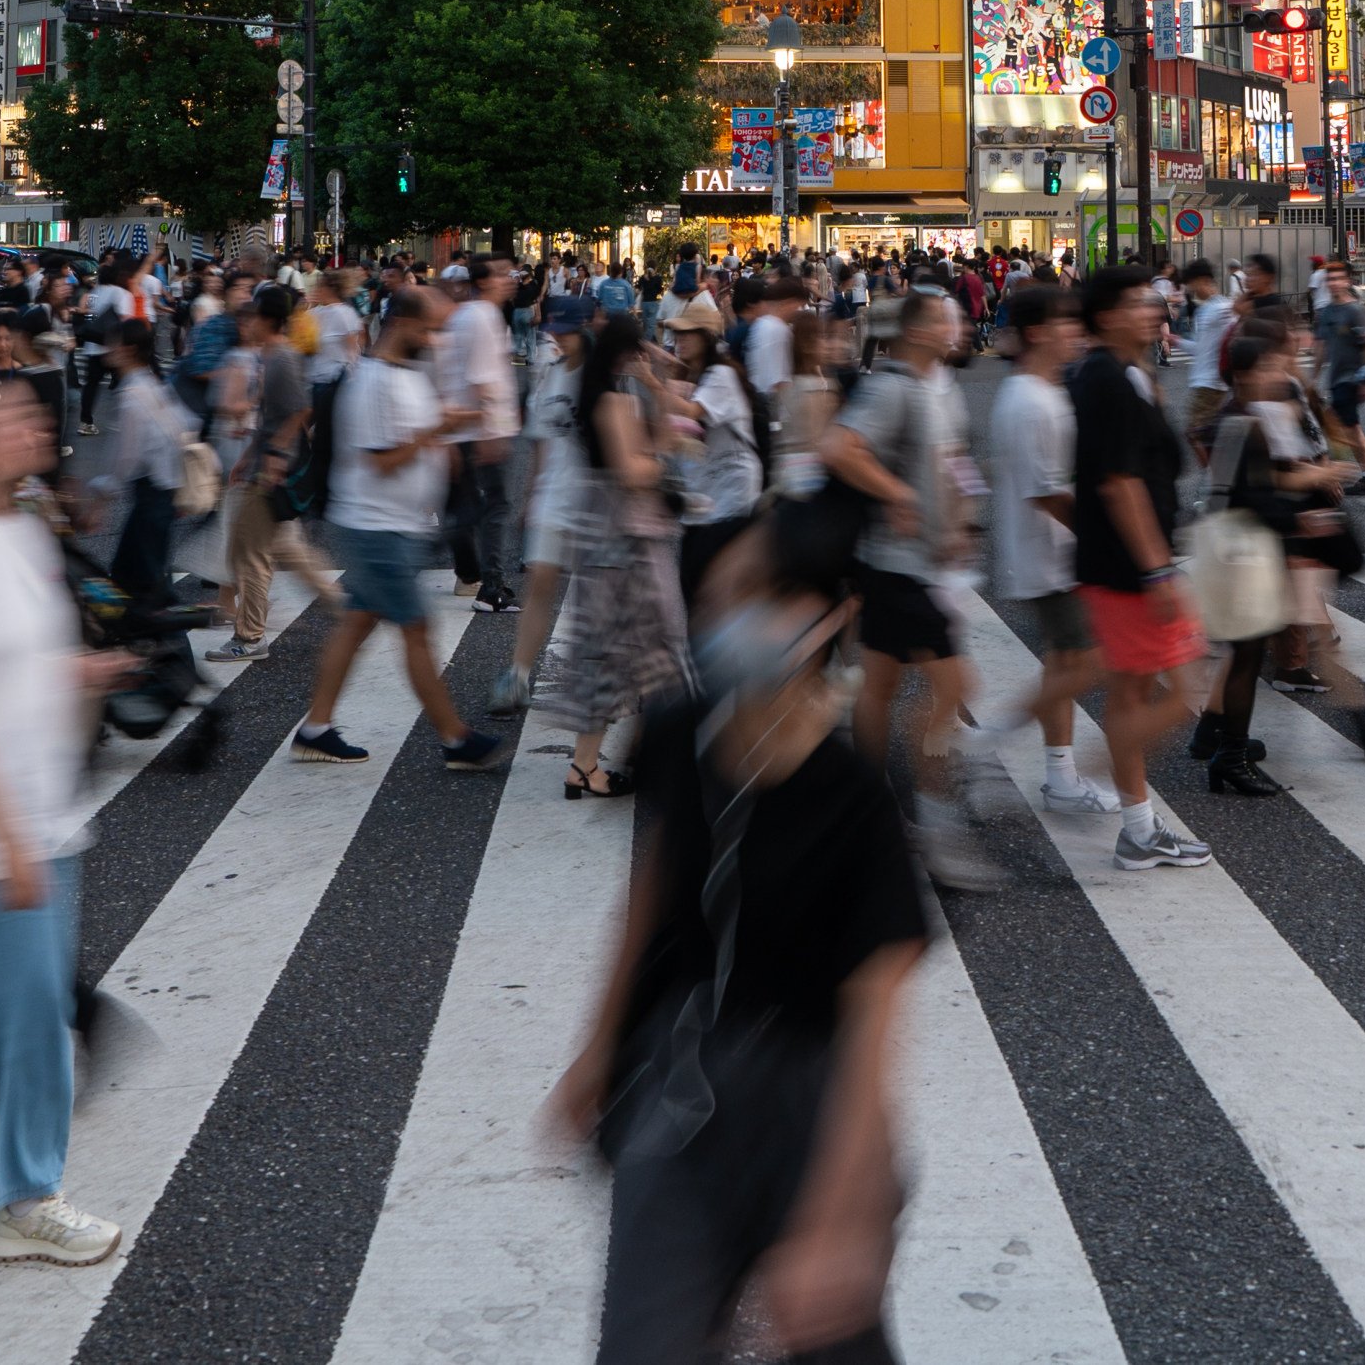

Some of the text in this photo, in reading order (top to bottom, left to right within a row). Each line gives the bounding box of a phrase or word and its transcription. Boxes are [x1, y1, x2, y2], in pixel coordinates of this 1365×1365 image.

[1161, 3, 1174, 54] 渋谷駅前
[1244, 86, 1282, 123] LUSH
